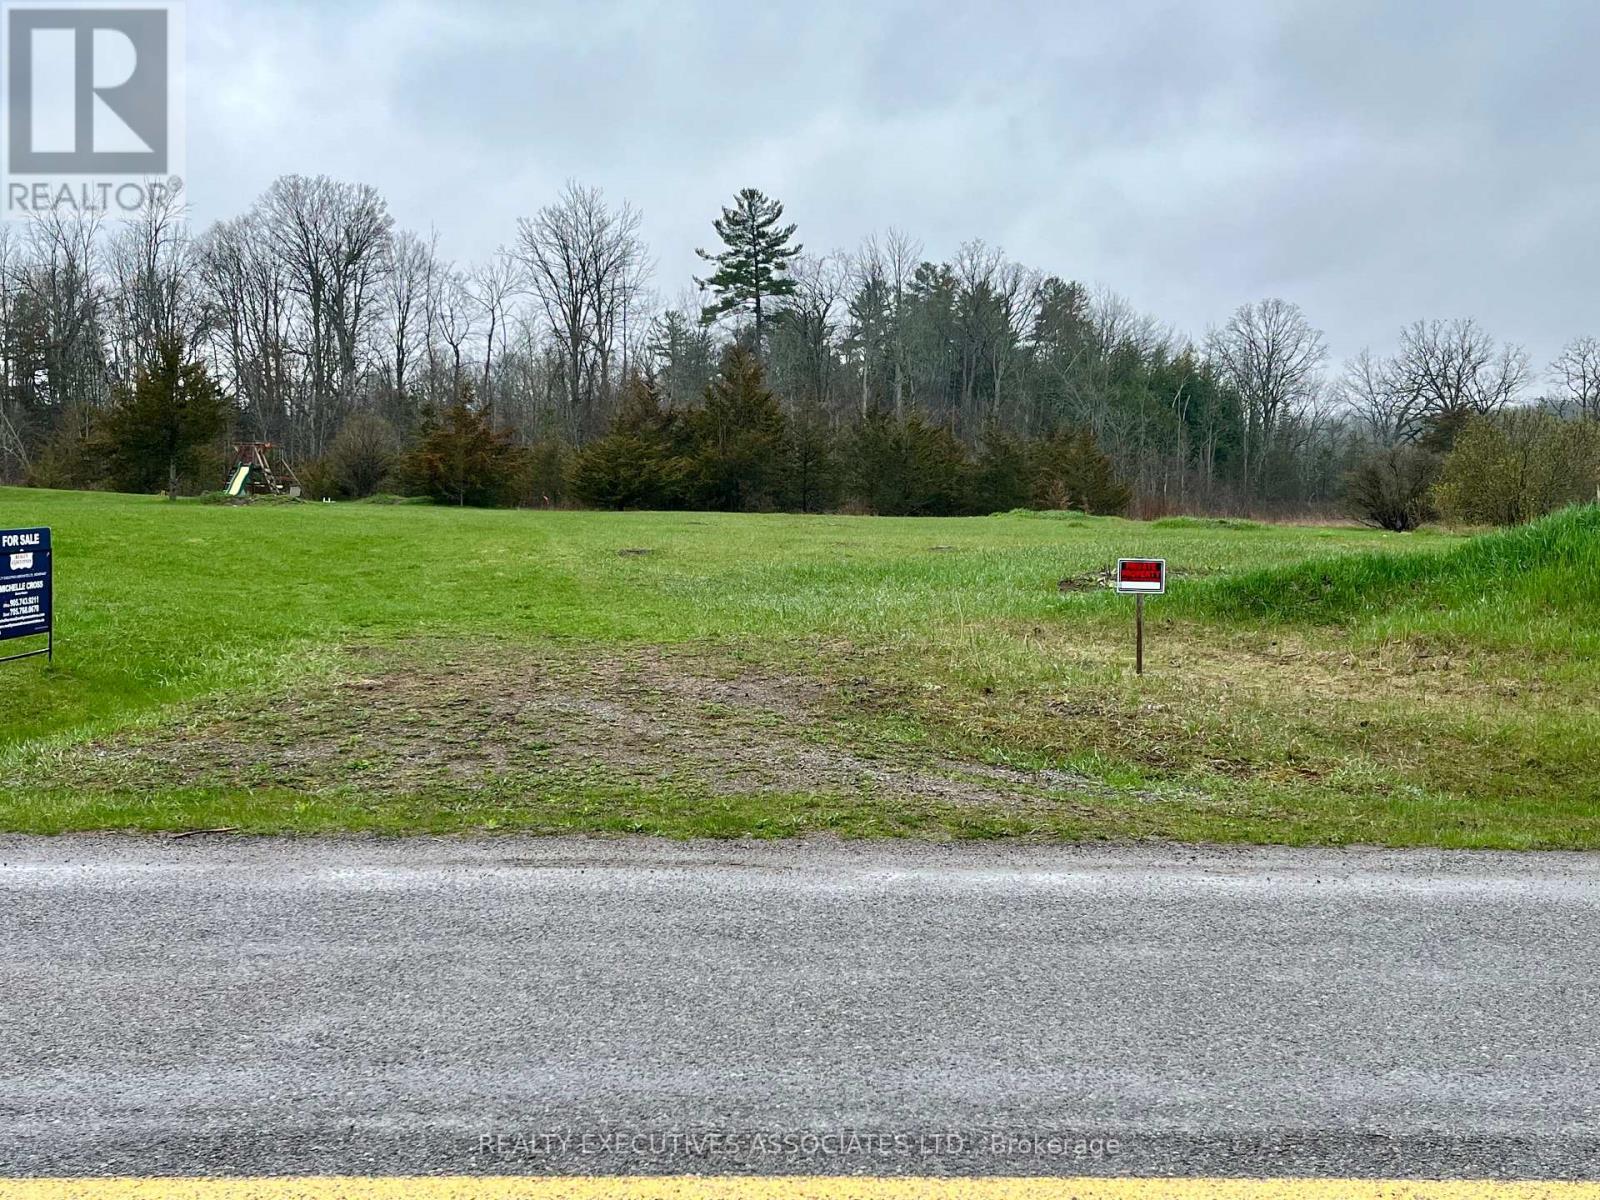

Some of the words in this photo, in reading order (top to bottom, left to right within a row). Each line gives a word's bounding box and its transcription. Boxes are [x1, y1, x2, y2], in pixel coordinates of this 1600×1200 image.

[2, 535, 19, 547] FOR
[20, 533, 40, 545] SALE
[26, 580, 44, 590] CROSS
